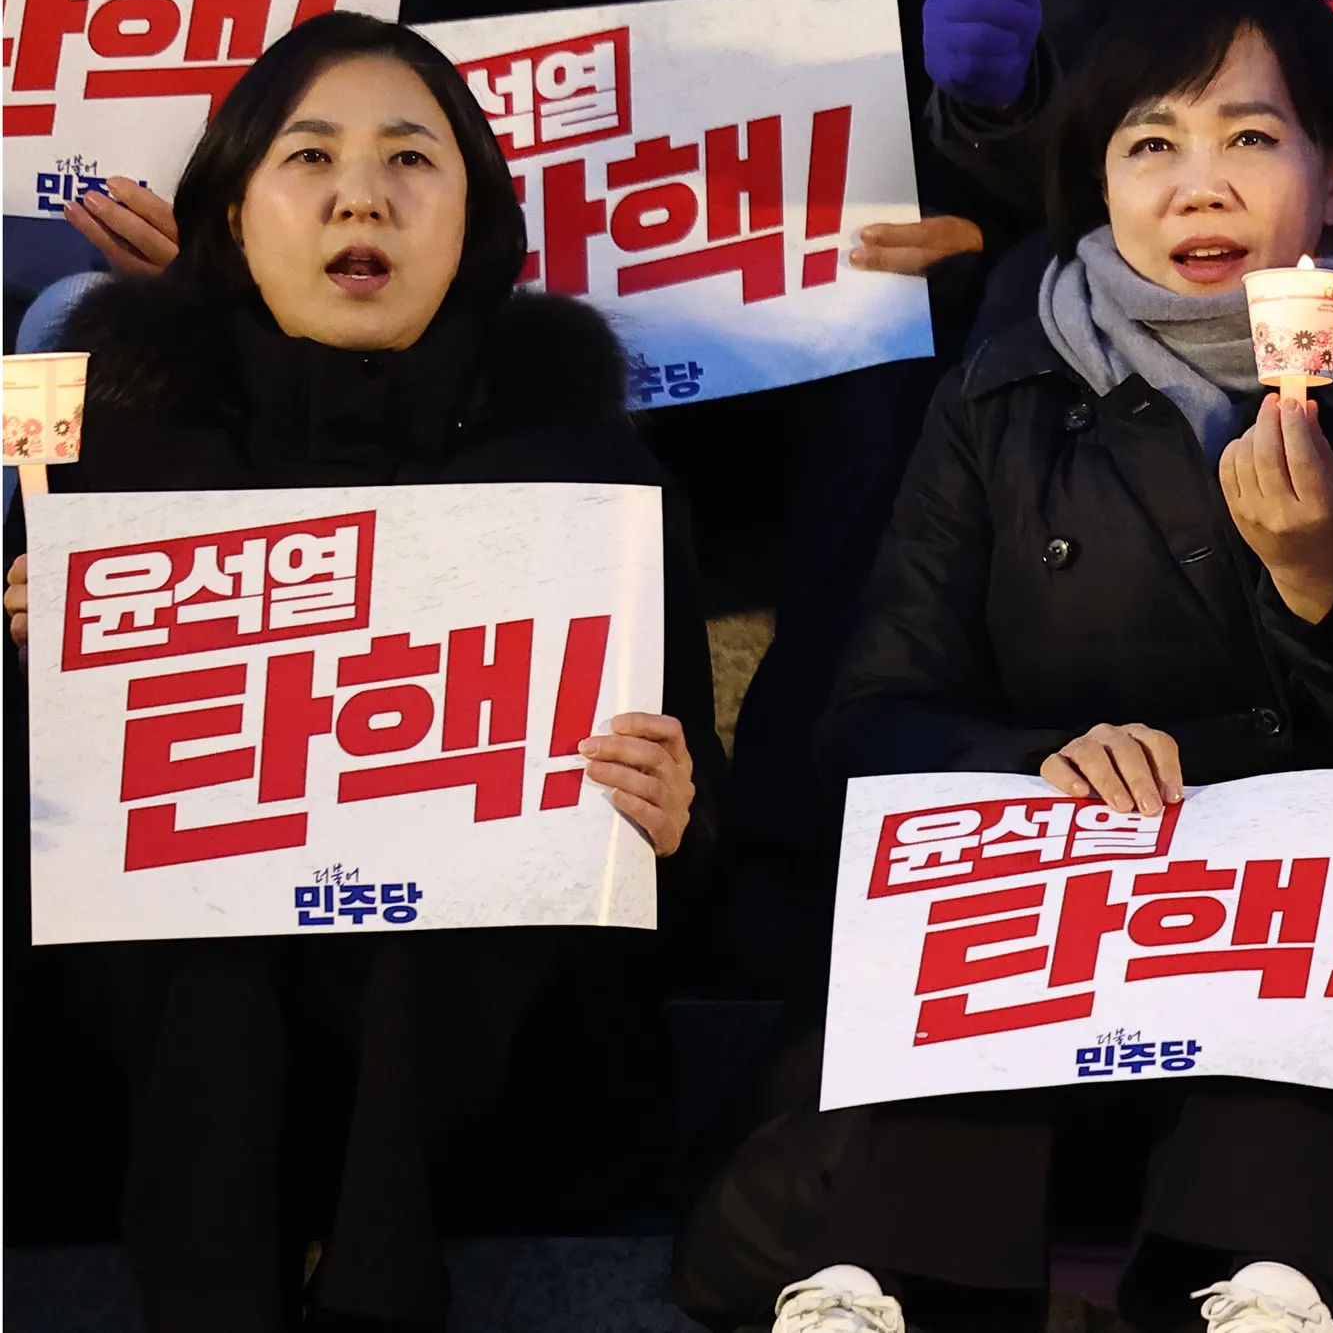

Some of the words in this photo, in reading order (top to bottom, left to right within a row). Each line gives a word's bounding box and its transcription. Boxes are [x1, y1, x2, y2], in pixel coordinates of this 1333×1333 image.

[468, 39, 619, 149] 석열
[80, 524, 359, 655] 윤석열
[120, 615, 611, 873] 탄핵!
[313, 862, 359, 887] 더불어
[887, 803, 1167, 887] 윤석열
[295, 882, 424, 926] 민주당
[1076, 1040, 1203, 1077] 민주당
[1096, 1027, 1142, 1046] 더불어
